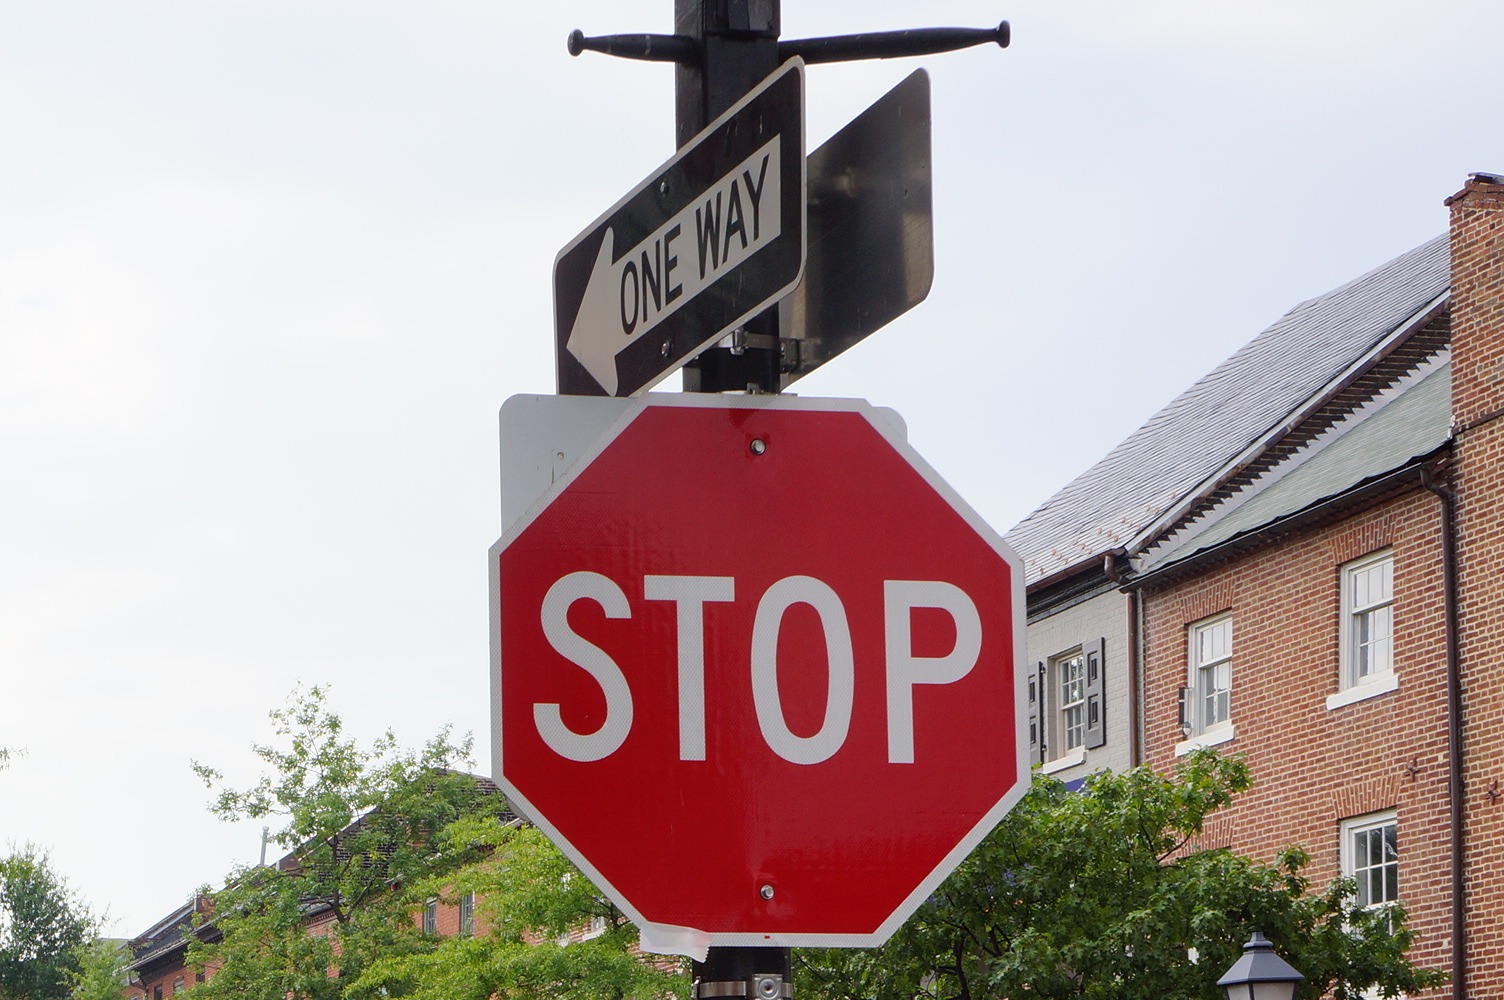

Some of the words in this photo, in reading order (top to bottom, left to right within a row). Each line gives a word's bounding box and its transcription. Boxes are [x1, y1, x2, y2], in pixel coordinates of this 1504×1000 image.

[620, 222, 683, 335] ONE
[695, 153, 770, 281] WAY
[532, 571, 983, 766] STOP
